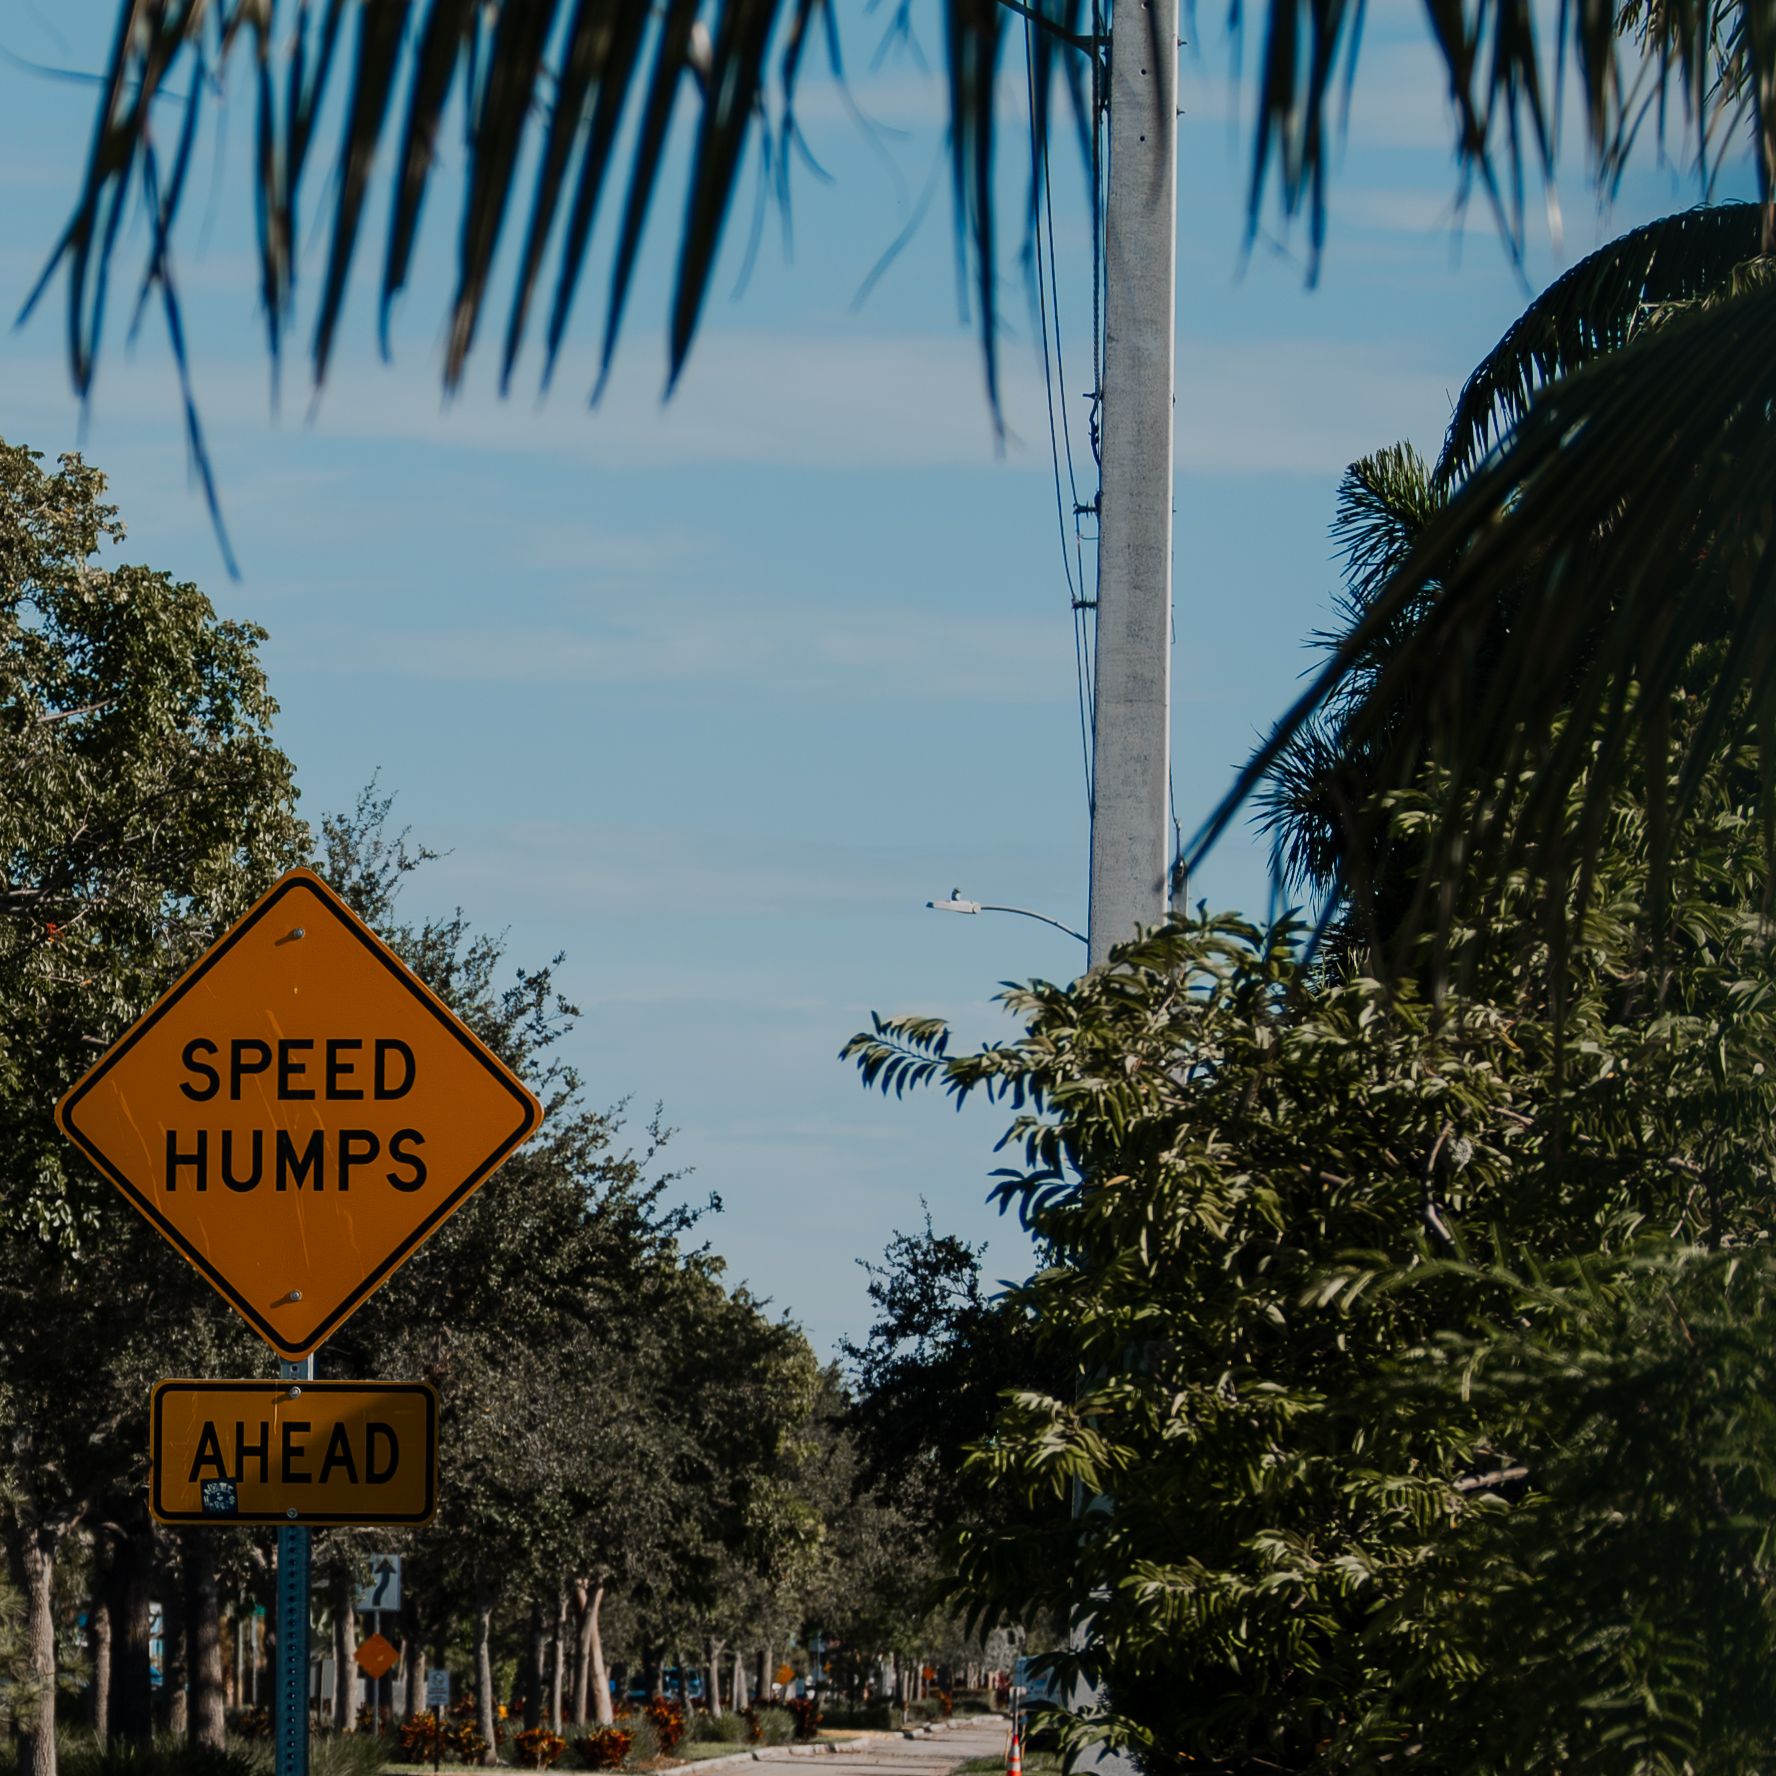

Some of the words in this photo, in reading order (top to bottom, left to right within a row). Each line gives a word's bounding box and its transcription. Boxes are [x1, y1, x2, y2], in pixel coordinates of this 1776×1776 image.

[179, 1038, 417, 1102] SPEED
[165, 1128, 428, 1193] HUMPS
[188, 1421, 401, 1486] AHEAD
